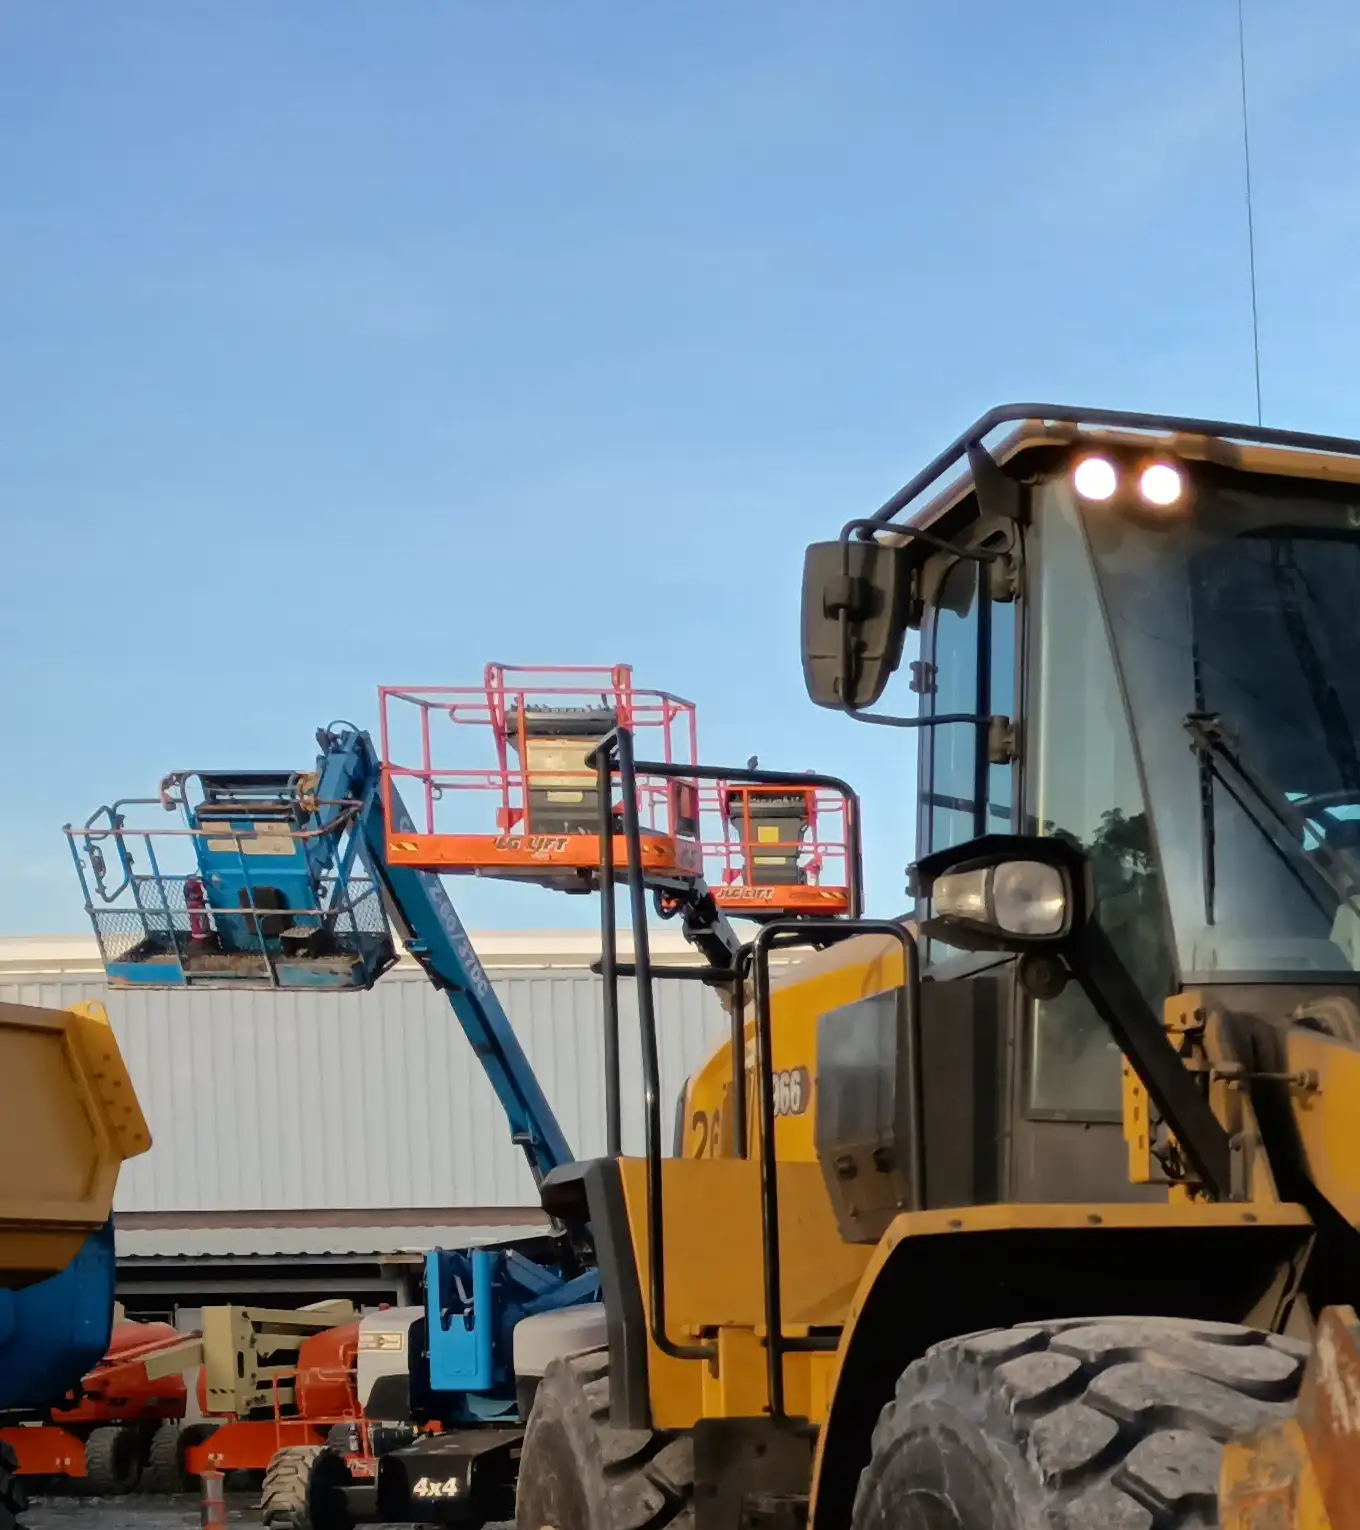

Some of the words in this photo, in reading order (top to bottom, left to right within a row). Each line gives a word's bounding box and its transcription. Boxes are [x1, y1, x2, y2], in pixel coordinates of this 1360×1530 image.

[716, 887, 742, 900] JLG
[743, 887, 775, 900] LIFT
[412, 1476, 458, 1497] 4x4
